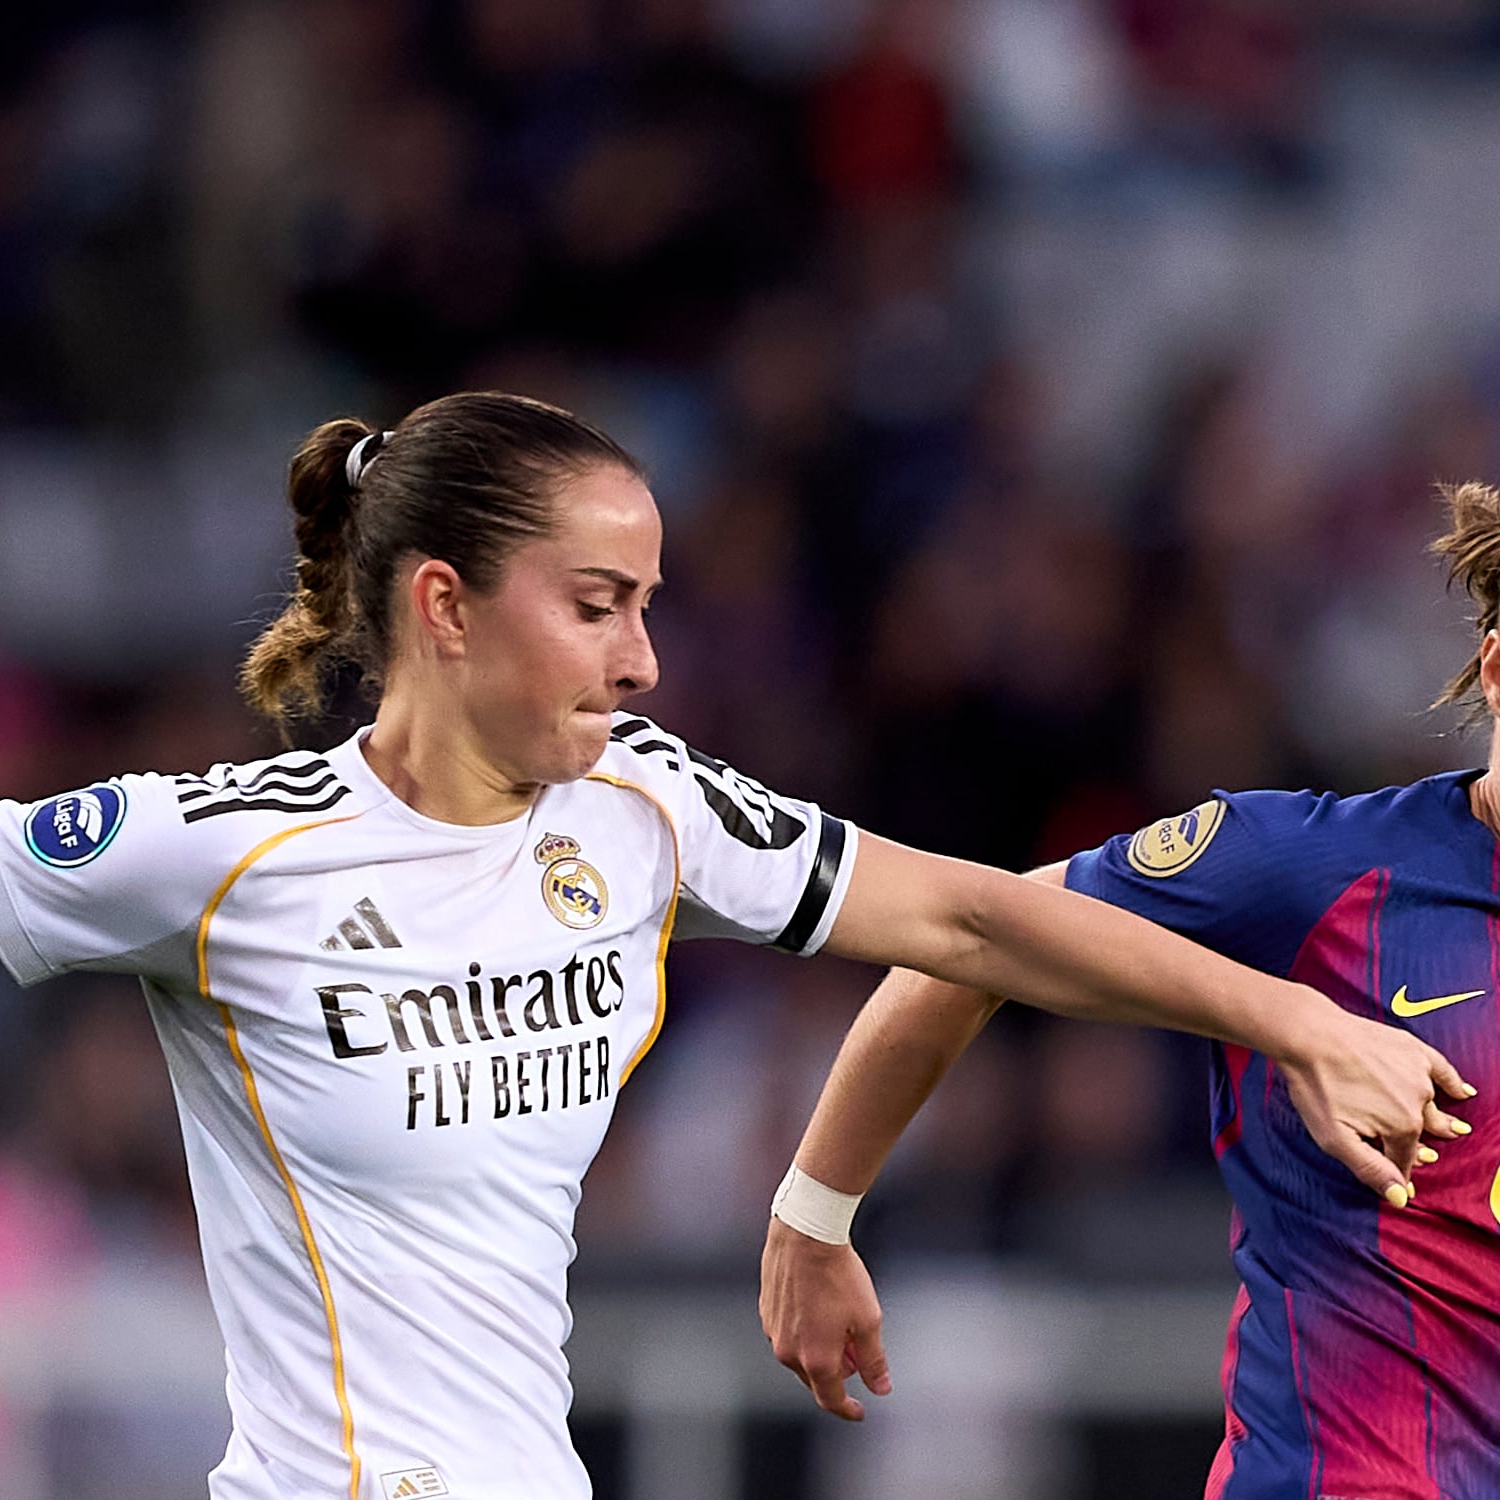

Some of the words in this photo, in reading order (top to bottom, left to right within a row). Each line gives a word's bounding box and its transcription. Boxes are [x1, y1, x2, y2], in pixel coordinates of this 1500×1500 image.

[313, 949, 625, 1060] Emirates
[406, 1060, 472, 1131] FLY
[490, 1035, 611, 1120] BETTER
